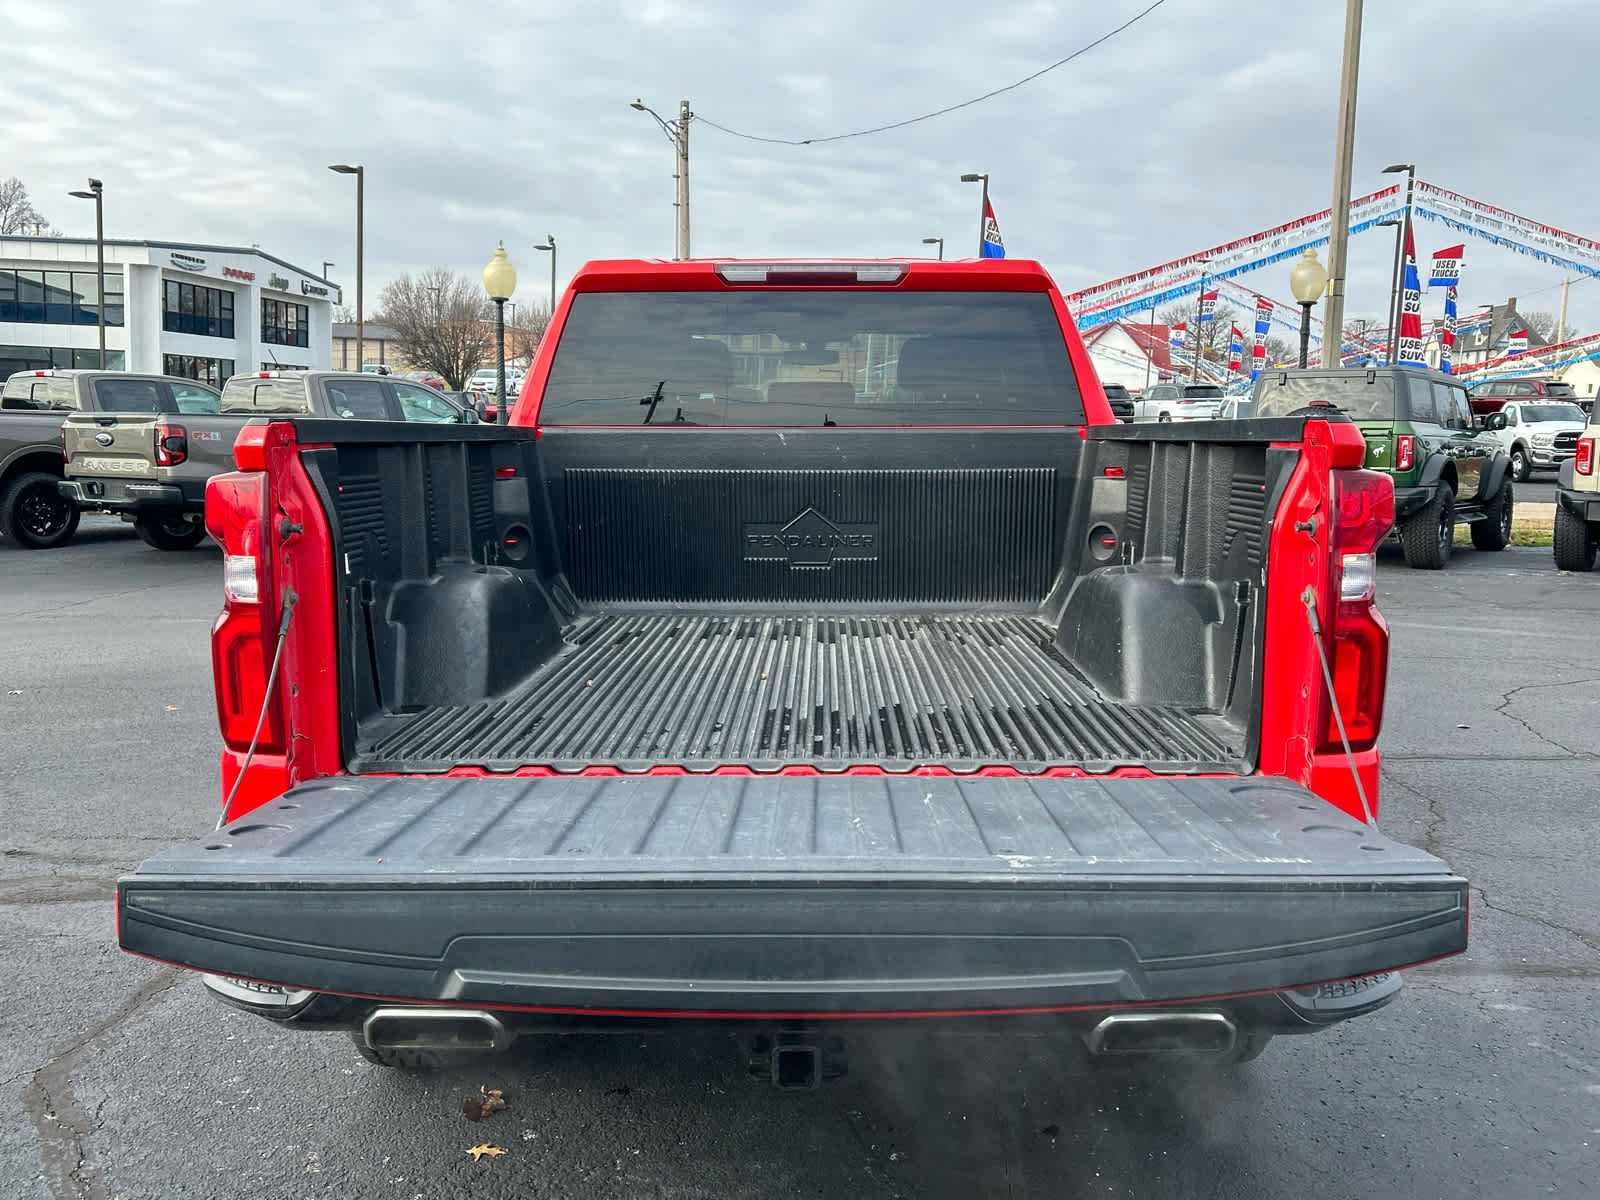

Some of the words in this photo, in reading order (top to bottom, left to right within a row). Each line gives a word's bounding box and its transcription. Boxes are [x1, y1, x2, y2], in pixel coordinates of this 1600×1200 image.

[1436, 260, 1456, 269] USED
[1432, 269, 1459, 278] TRUCKS
[1404, 290, 1419, 301] US
[1404, 302, 1420, 313] SU
[1400, 338, 1422, 350] USE
[746, 534, 873, 548] PENDALINER
